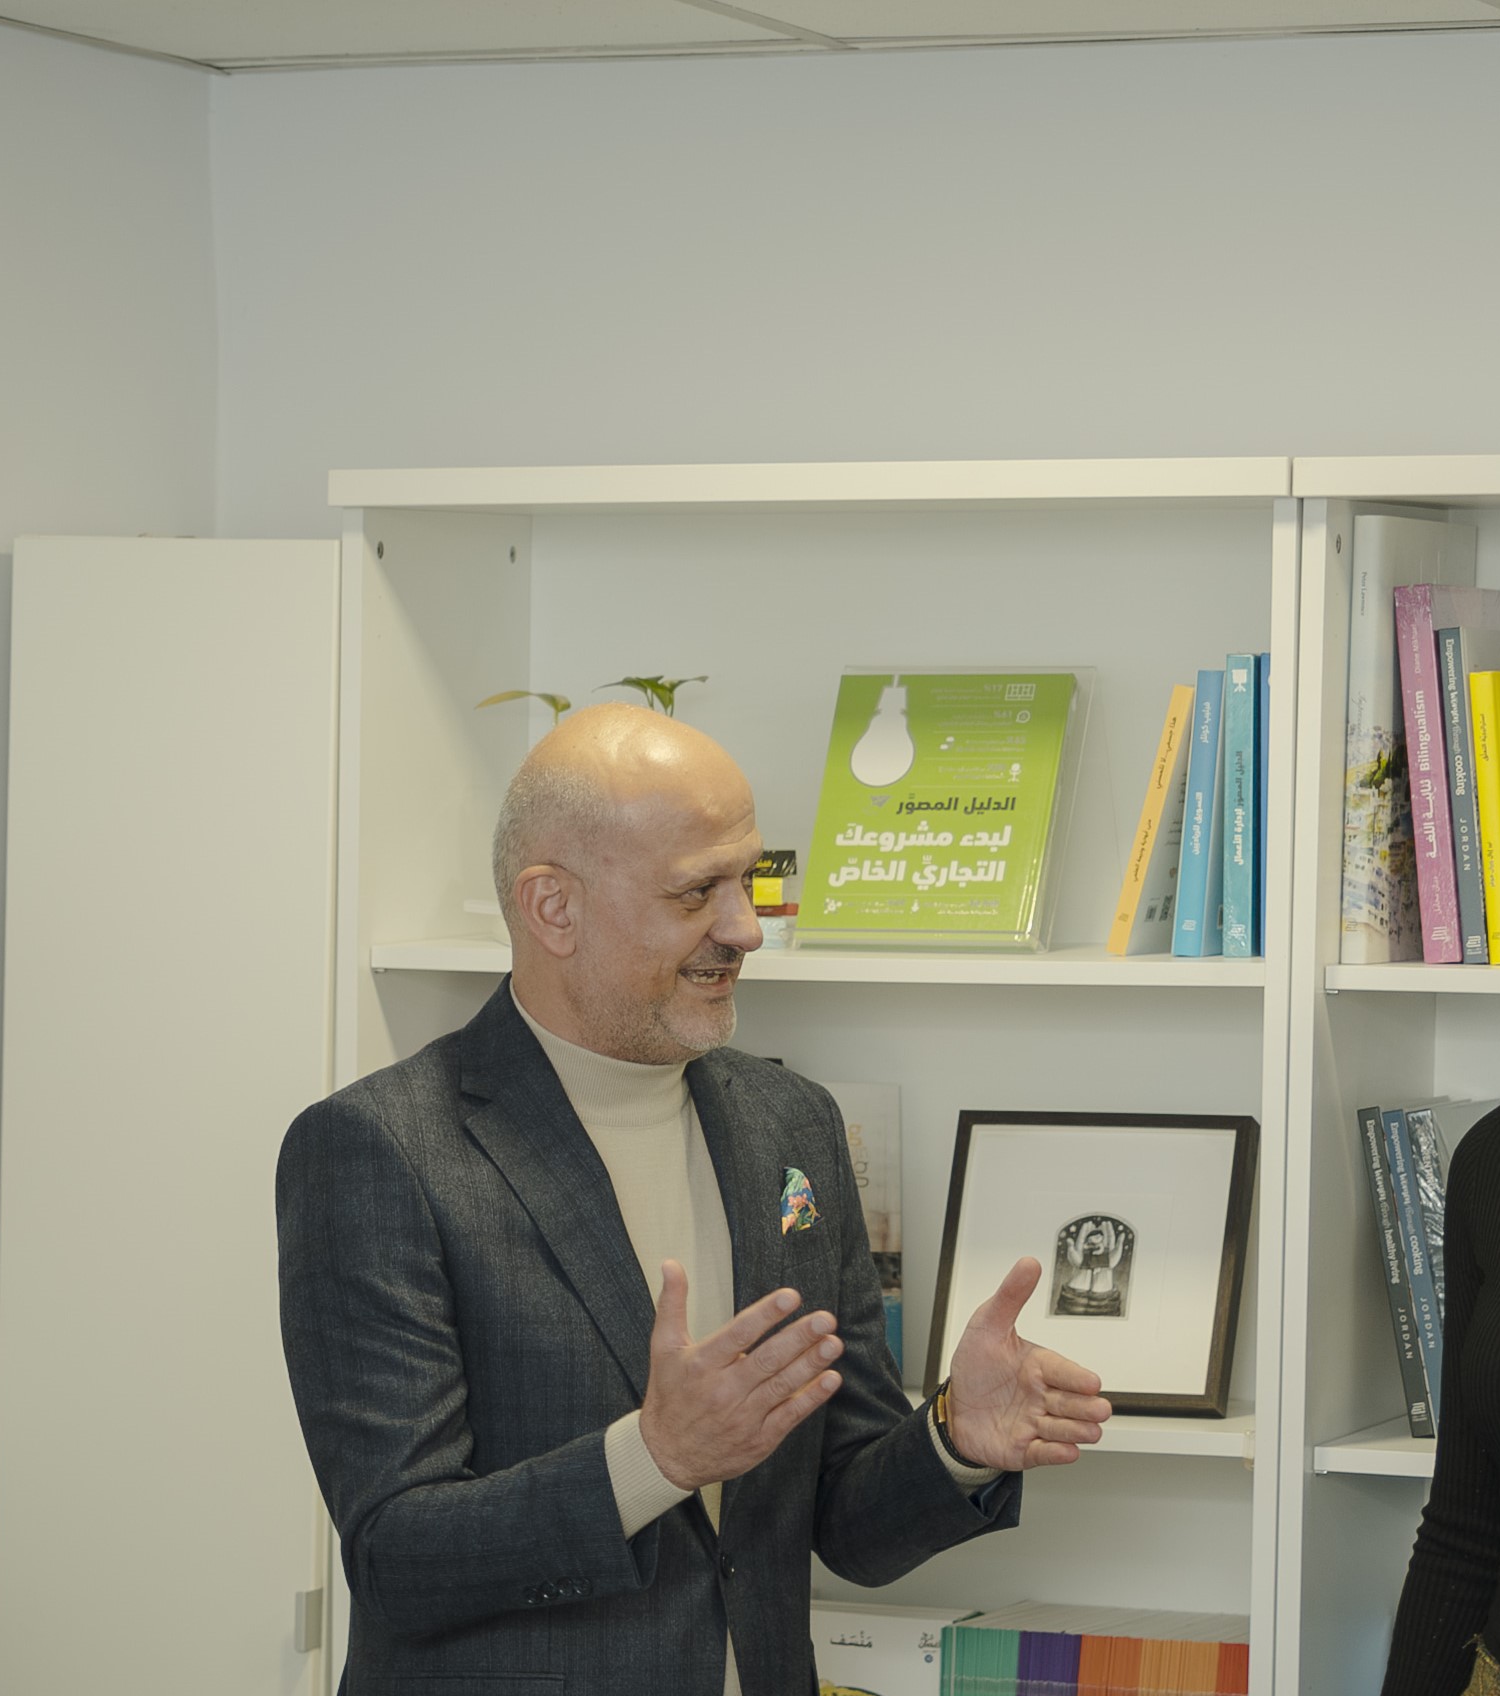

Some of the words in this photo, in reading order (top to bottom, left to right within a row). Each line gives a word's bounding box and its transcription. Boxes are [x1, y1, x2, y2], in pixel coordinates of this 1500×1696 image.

[1412, 689, 1433, 772] Bilingualism
[1445, 638, 1459, 692] Empowering
[1453, 754, 1466, 796] cooking
[963, 796, 1017, 815] الدليل
[959, 824, 1013, 853] لبدء
[1421, 821, 1437, 859] اللغة
[1459, 817, 1471, 872] JORDAN
[828, 857, 908, 888] الخاصّ
[911, 854, 1007, 891] التجاريّ
[1366, 1119, 1382, 1170] Empowering
[1390, 1121, 1405, 1173] Empowering
[1408, 1235, 1425, 1276] cooking
[1383, 1229, 1398, 1259] healthy
[1388, 1259, 1402, 1284] living
[1397, 1307, 1414, 1360] JORDAN
[1420, 1296, 1436, 1349] JORDAN
